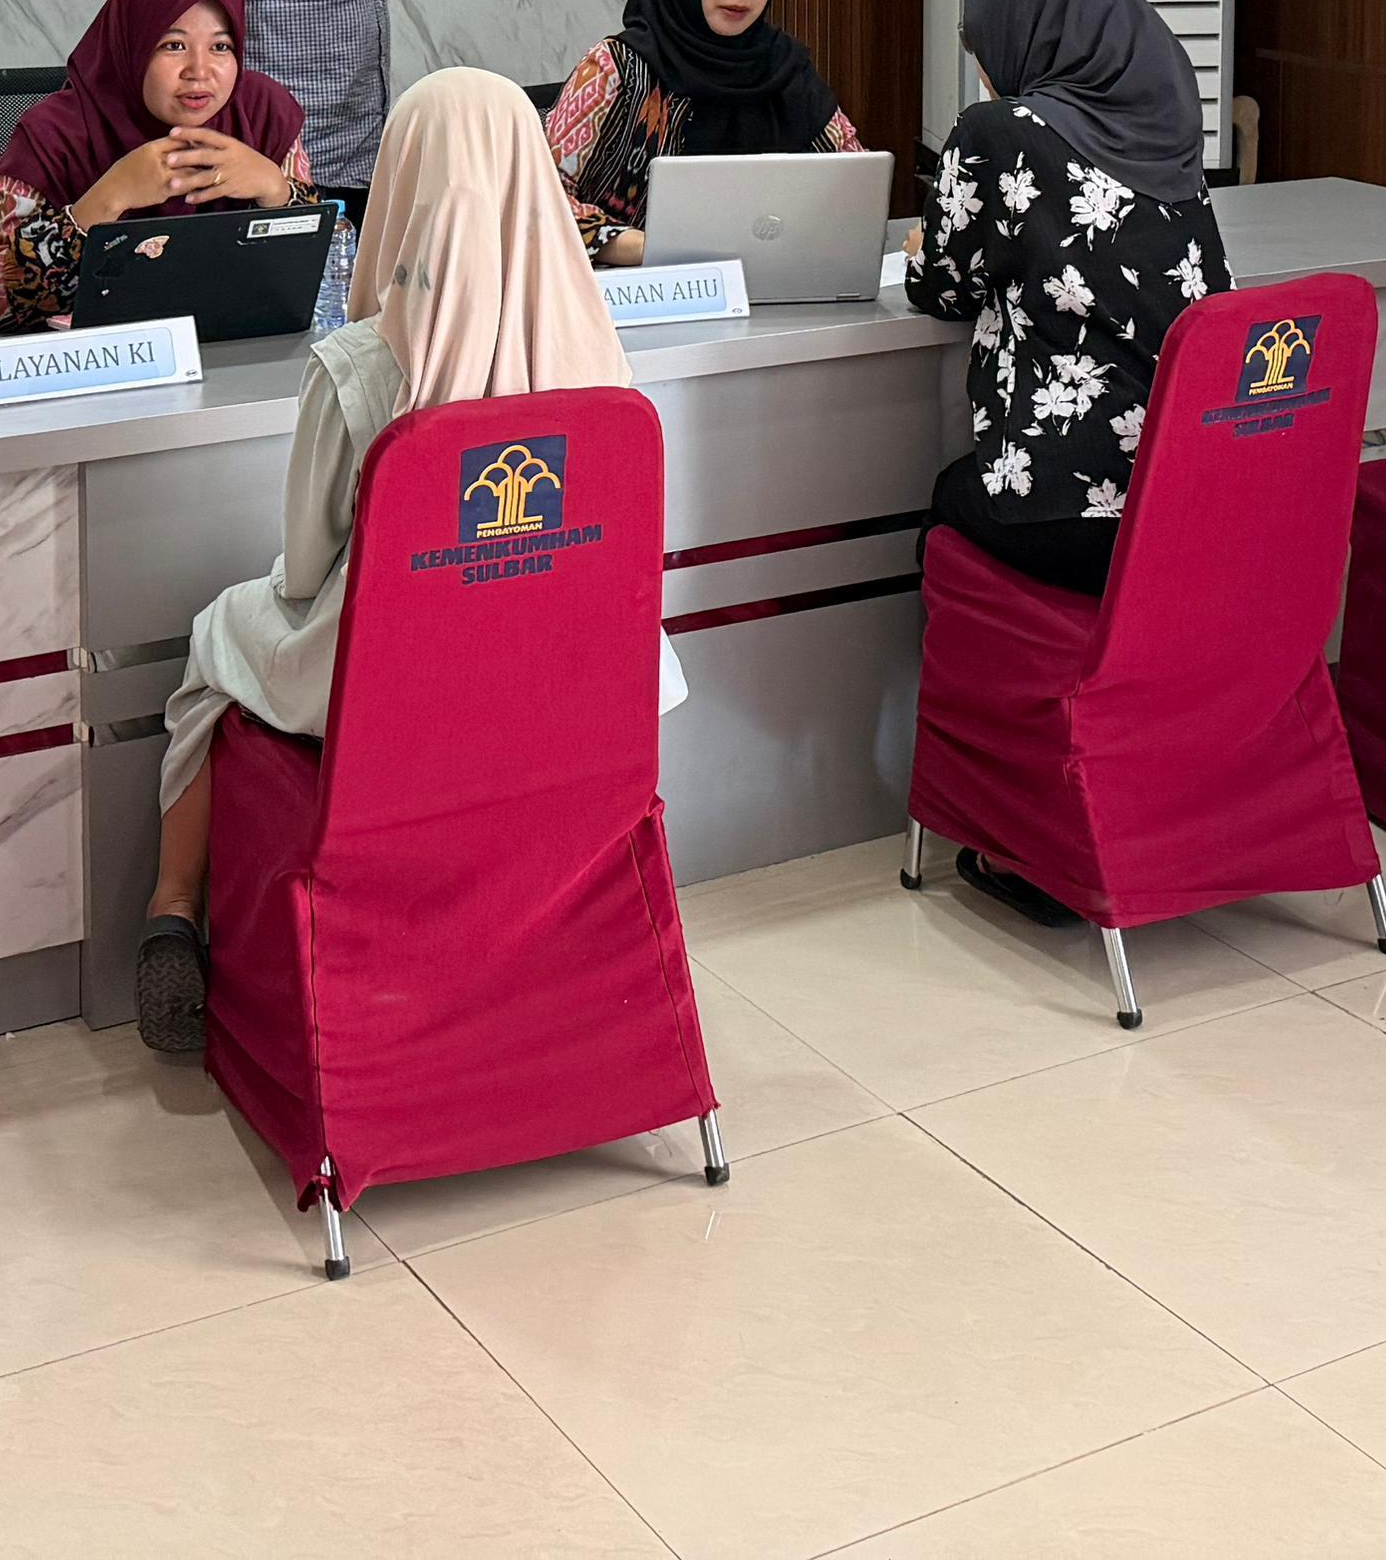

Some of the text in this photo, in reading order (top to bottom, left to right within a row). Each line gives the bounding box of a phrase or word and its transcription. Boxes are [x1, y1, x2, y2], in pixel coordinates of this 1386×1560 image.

[604, 278, 718, 306] ANAN AHU
[128, 341, 156, 364] KI
[476, 522, 543, 539] PENGAYOMAN
[410, 524, 602, 572] KEMENKUMHAM
[462, 554, 553, 585] SULBAR
